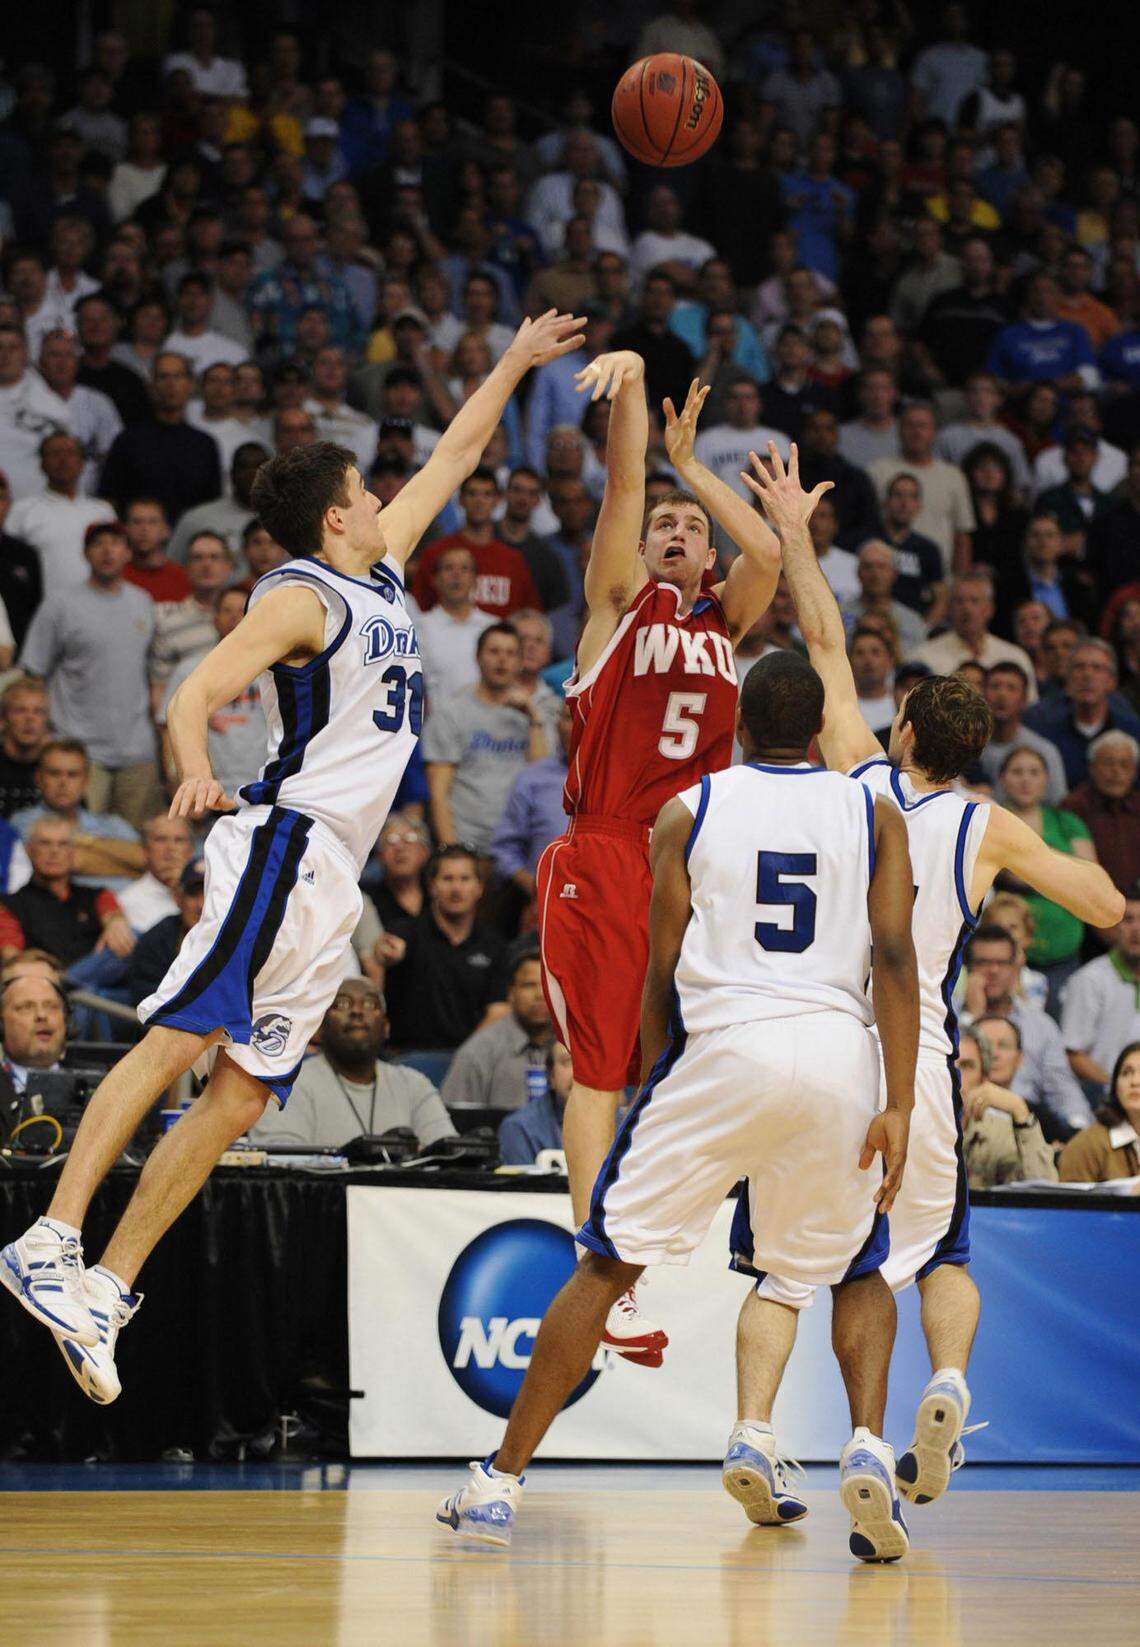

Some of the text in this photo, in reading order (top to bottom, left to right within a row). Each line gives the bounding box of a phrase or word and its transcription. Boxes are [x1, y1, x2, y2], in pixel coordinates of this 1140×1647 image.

[359, 614, 422, 666] Drak
[633, 623, 738, 687] WKU
[657, 691, 708, 760] 5
[754, 850, 817, 954] 5
[453, 1316, 607, 1370] NC
